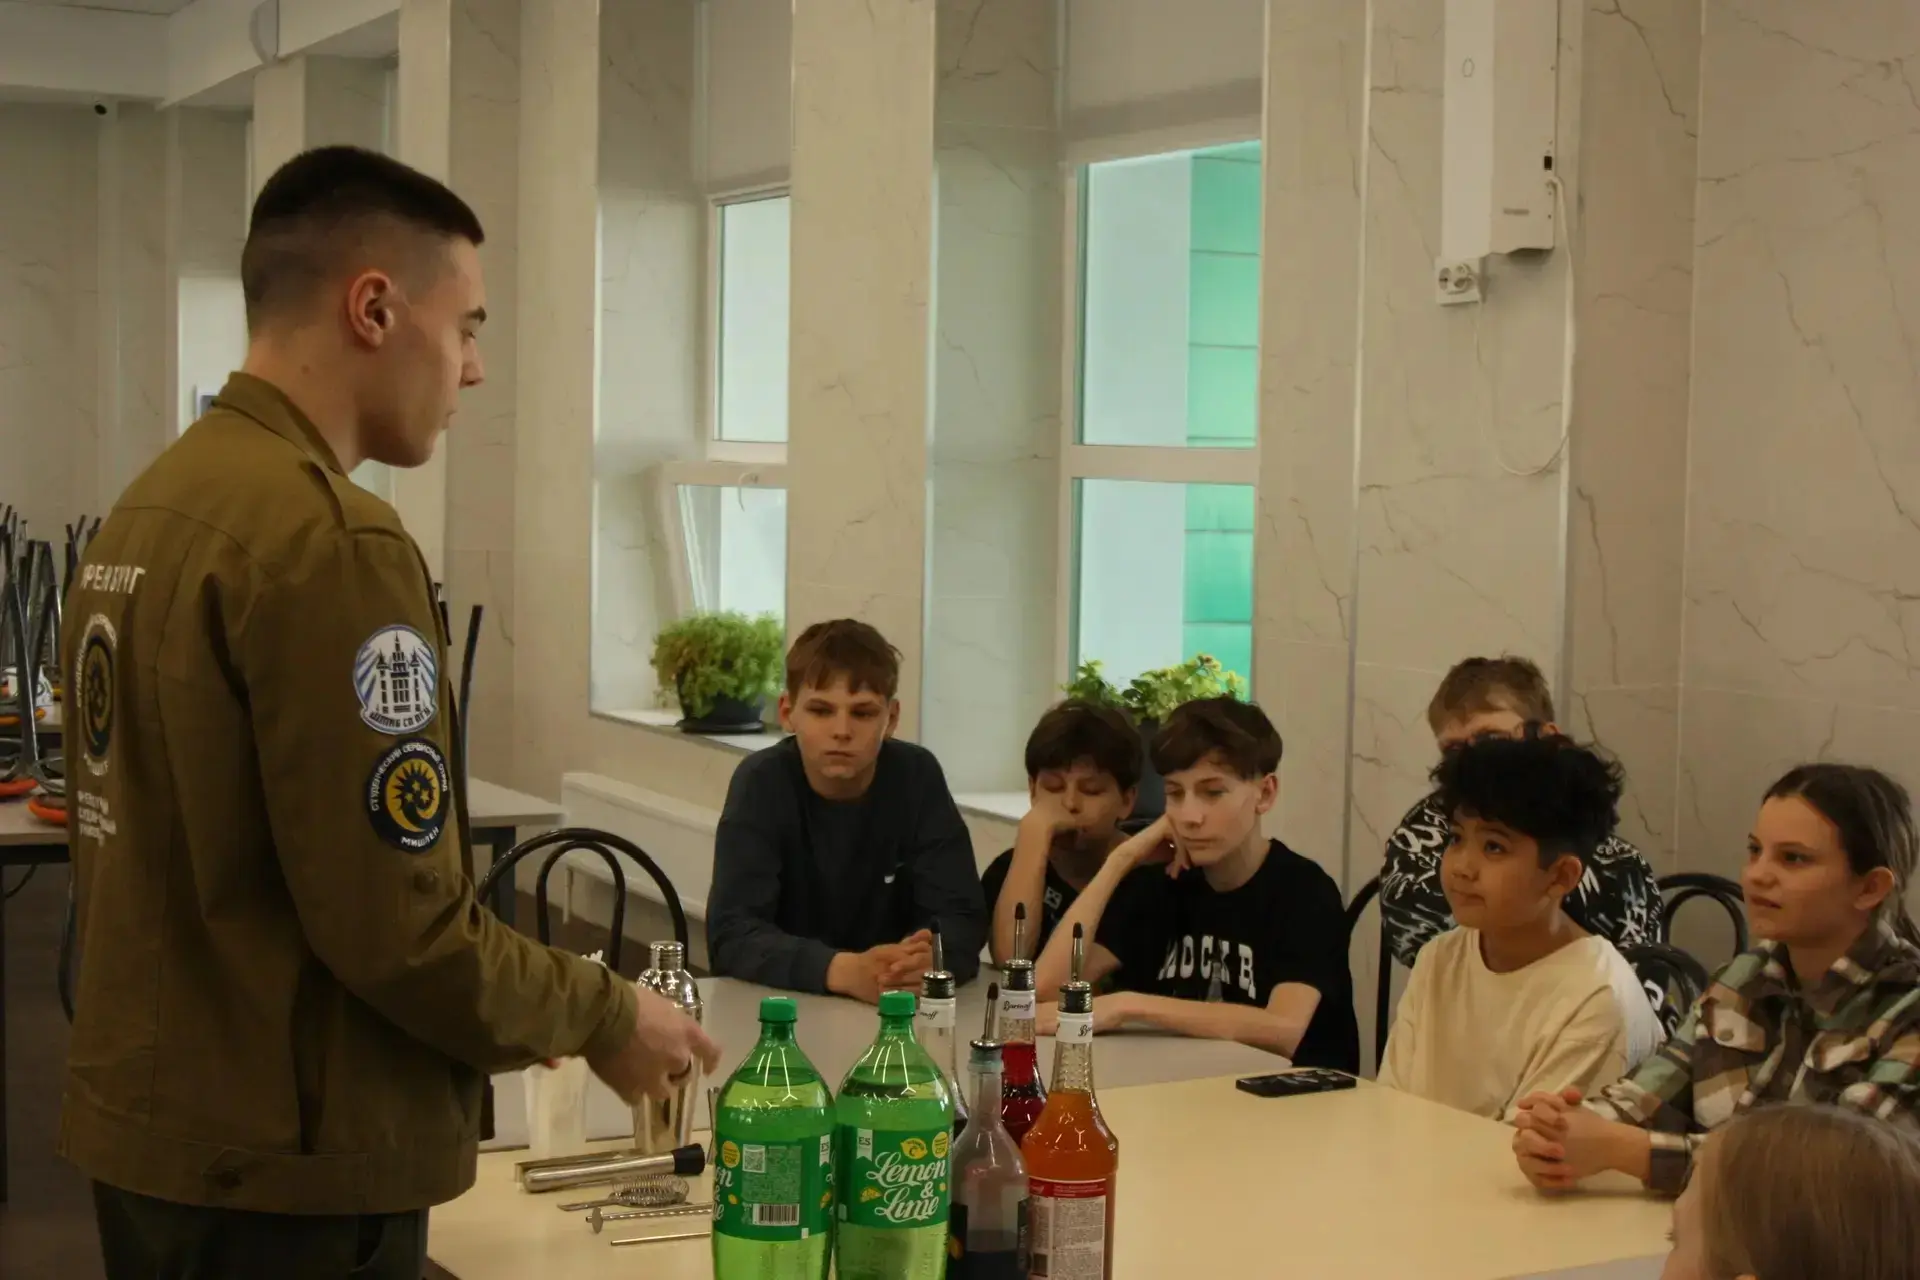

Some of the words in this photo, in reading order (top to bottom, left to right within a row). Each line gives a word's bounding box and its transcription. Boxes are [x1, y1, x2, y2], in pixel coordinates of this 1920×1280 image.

[400, 826, 440, 848] МИШЛЕН
[1156, 934, 1257, 1000] МОСКВ
[866, 1152, 946, 1188] Lemon
[874, 1186, 940, 1223] Lime
[920, 1181, 934, 1199] &
